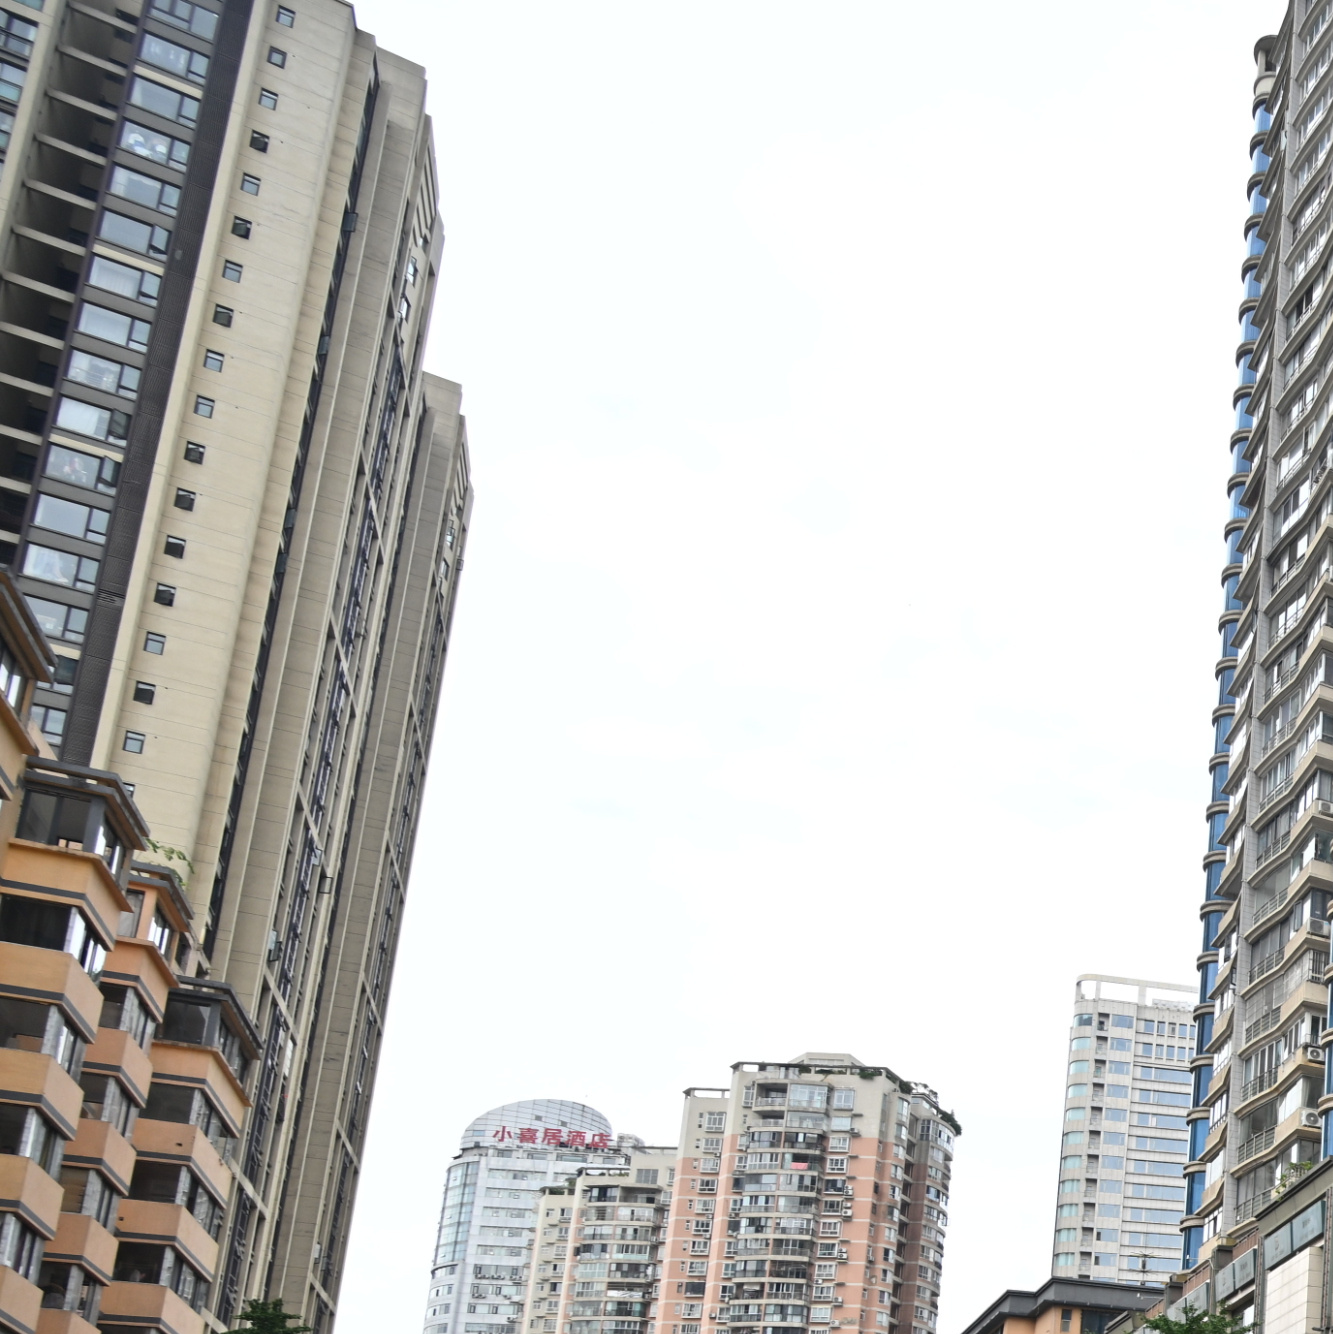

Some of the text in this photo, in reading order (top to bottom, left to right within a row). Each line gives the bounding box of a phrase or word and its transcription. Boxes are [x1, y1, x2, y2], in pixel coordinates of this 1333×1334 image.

[492, 1126, 612, 1149] 小喜居酒店
